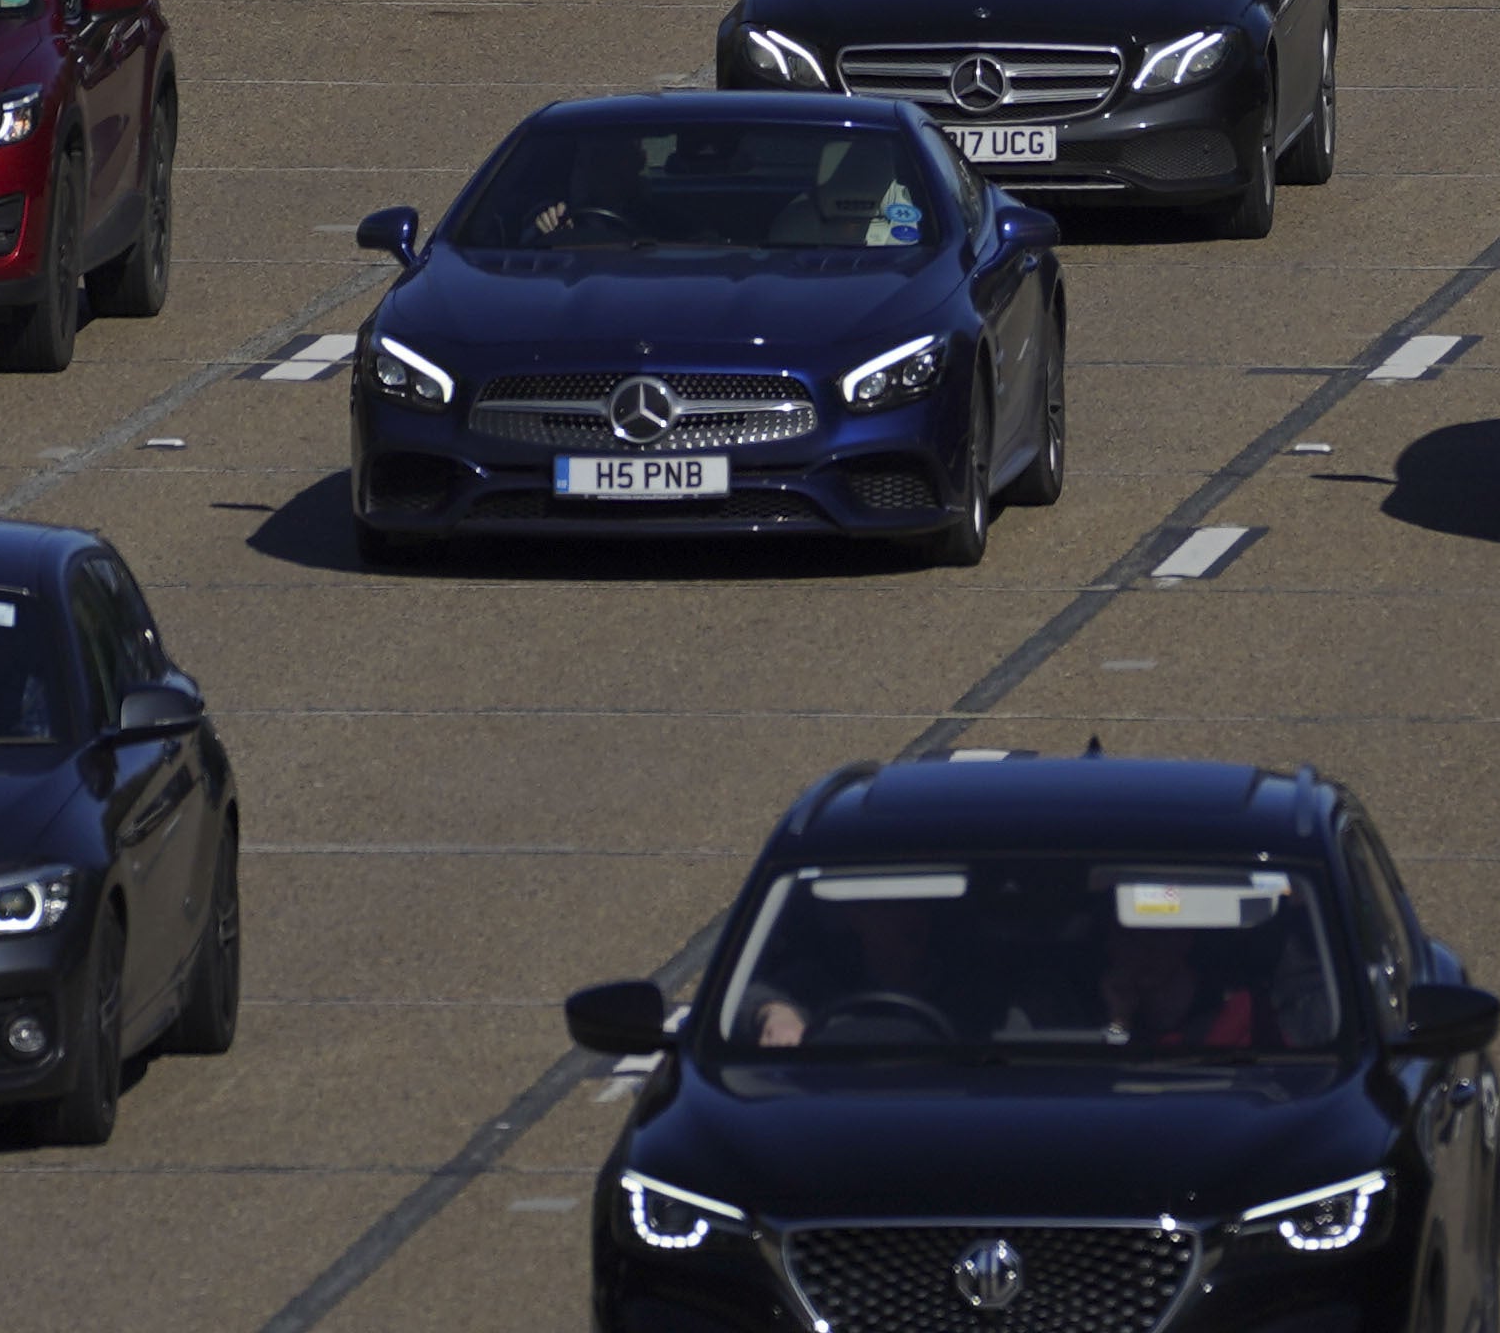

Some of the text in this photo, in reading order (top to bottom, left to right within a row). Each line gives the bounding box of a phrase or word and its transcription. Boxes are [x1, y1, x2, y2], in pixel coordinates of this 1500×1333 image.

[992, 131, 1044, 156] UCG
[596, 461, 702, 489] H5 PNB
